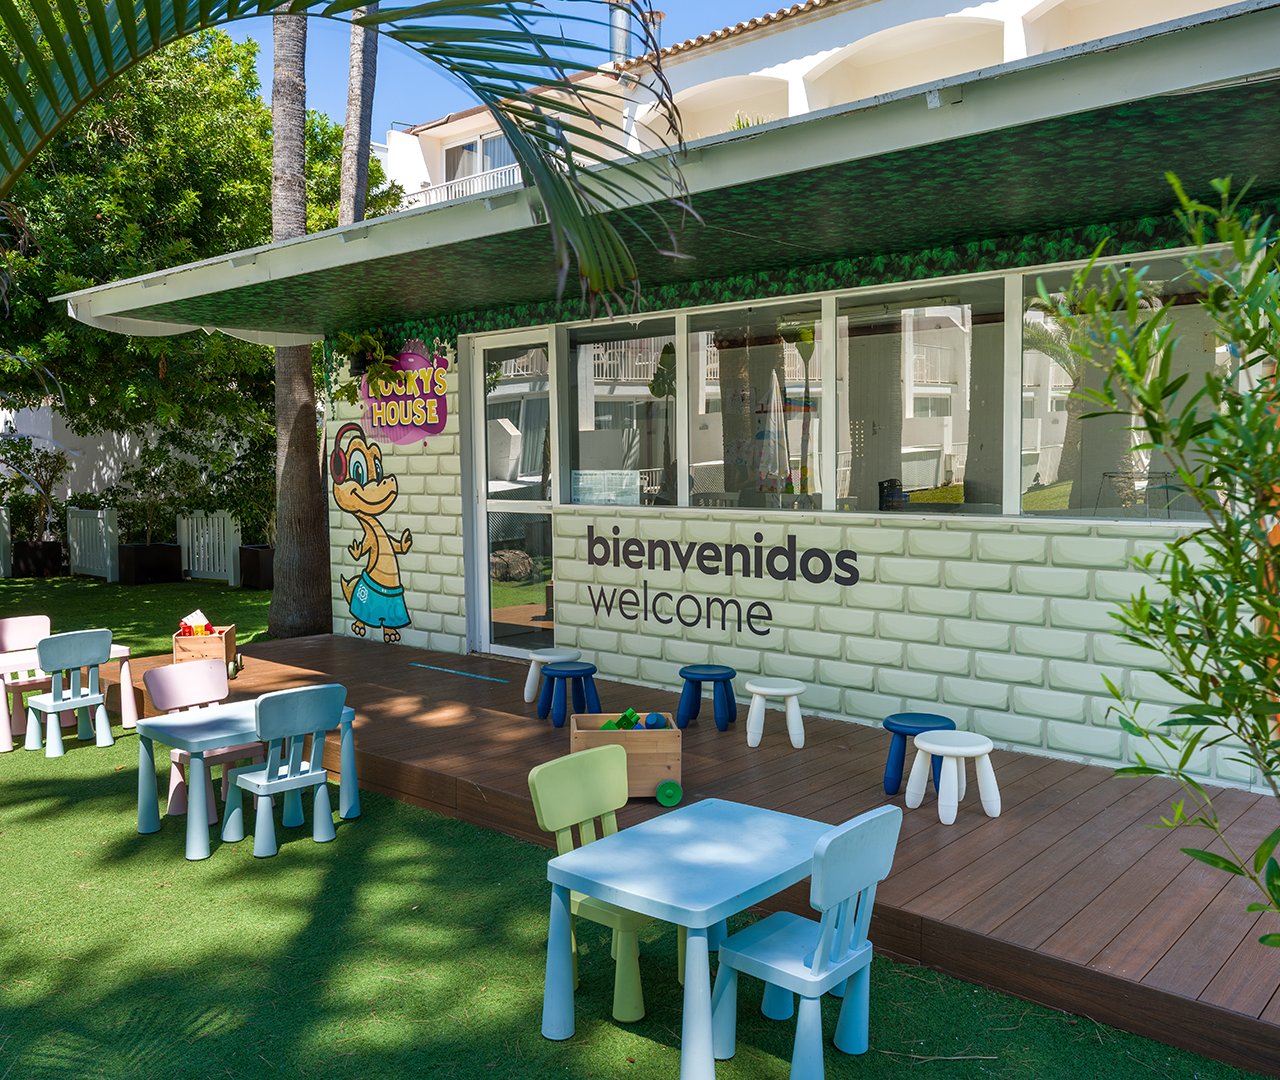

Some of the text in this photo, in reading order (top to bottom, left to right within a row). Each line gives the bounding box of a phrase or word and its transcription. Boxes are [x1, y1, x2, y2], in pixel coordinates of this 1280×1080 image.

[372, 398, 439, 427] HOUSE
[587, 524, 860, 587] bienvenidos
[587, 579, 774, 637] welcome
